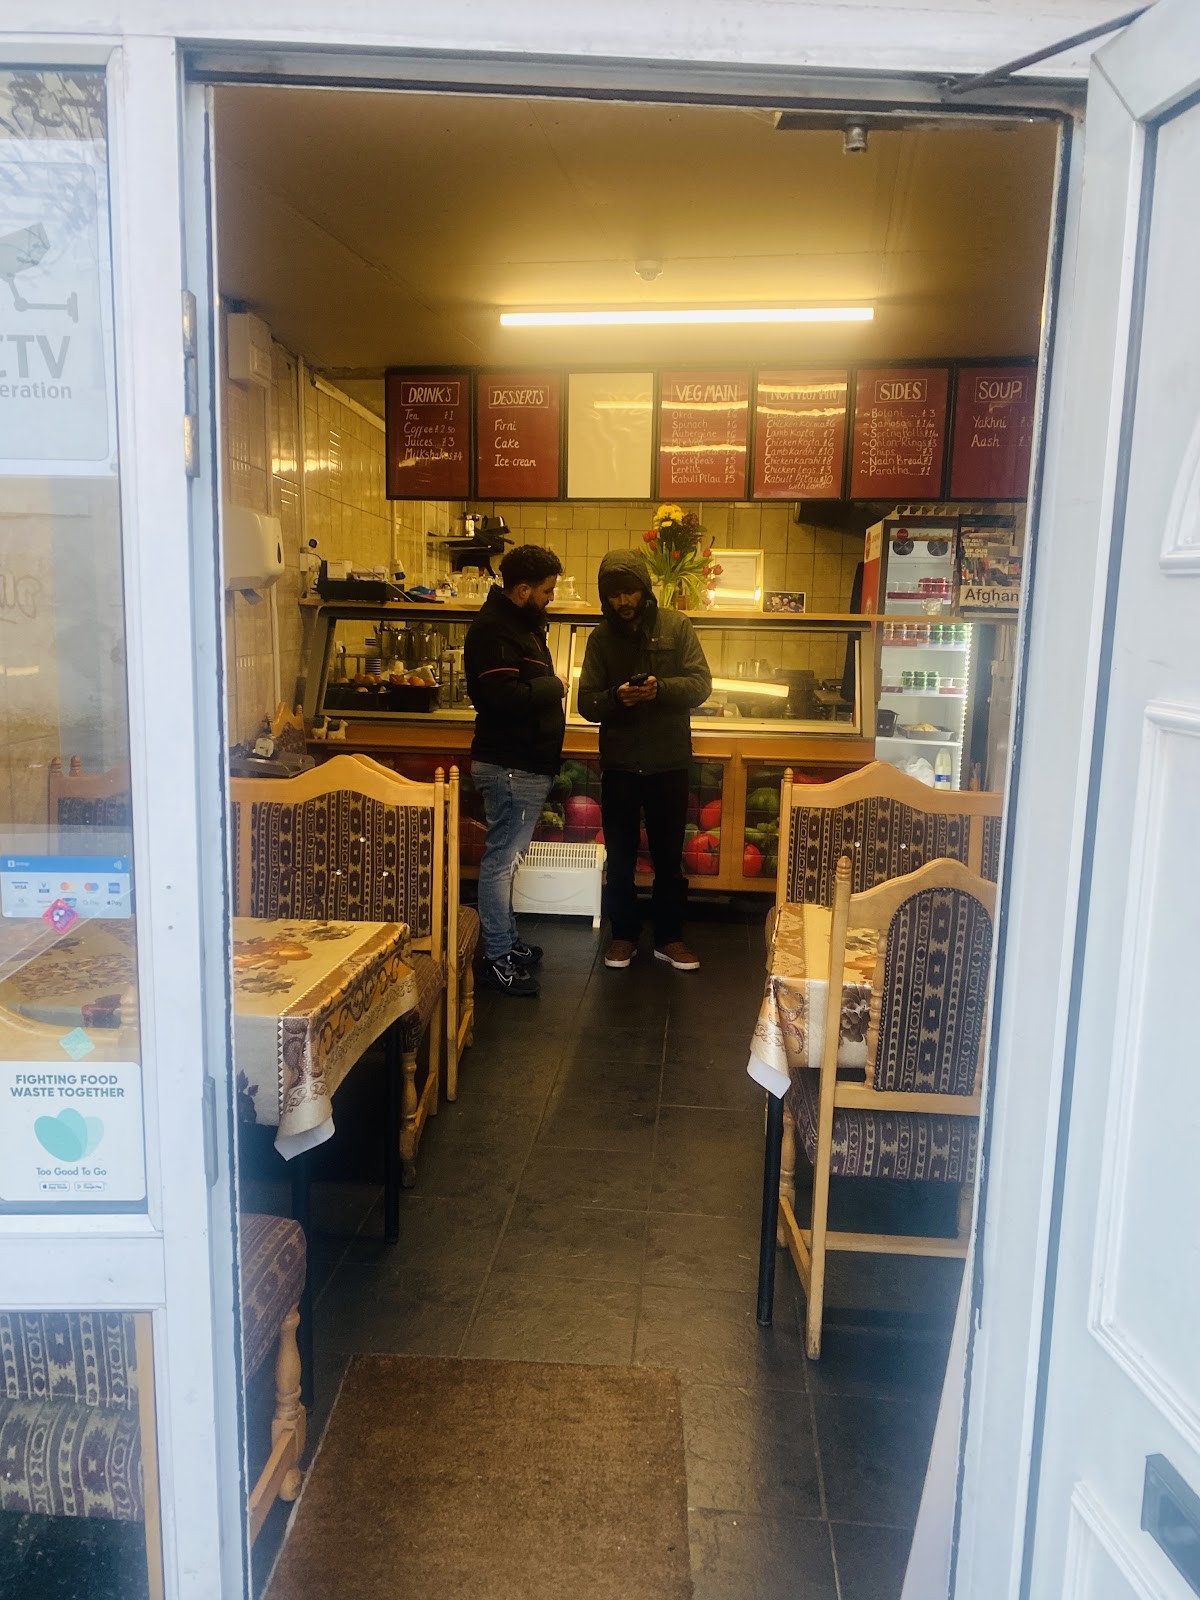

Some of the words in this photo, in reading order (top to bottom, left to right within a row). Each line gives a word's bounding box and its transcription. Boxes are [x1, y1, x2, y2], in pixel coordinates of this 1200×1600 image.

[0, 334, 71, 379] TV
[675, 384, 702, 401] VEG
[704, 384, 738, 402] MAIN
[880, 382, 922, 400] SIDES
[979, 381, 1022, 400] SOUP
[490, 389, 544, 405] DESSERTS
[404, 408, 420, 420] Tea
[672, 410, 693, 420] Okra
[871, 407, 904, 418] Bolani
[494, 418, 517, 431] Firni
[672, 419, 708, 431] Spinach
[767, 419, 798, 428] Chicken
[799, 419, 825, 428] Korma
[973, 415, 1007, 428] Yakhni
[403, 421, 433, 438] Coffee
[672, 429, 717, 440] Aubergine
[766, 428, 788, 438] Lamb
[870, 428, 902, 440] Spring
[404, 434, 433, 447] Juices
[494, 436, 520, 449] Cake
[765, 438, 797, 447] Chicken
[869, 438, 898, 448] Onion
[901, 436, 927, 451] Rings
[970, 433, 1000, 448] Aash
[765, 446, 789, 456] Lamb
[869, 447, 896, 458] Chips
[671, 456, 715, 467] Chickpeas
[764, 455, 794, 465] Chicken
[869, 456, 895, 466] Naan
[896, 454, 922, 466] Bread
[764, 465, 796, 474] Chicken
[797, 465, 817, 477] Legs
[869, 465, 910, 476] Paratha
[671, 474, 698, 484] Kabuli
[699, 473, 721, 484] Pilau
[965, 588, 1019, 603] Afghan
[15, 1074, 77, 1085] FIGHTING
[80, 1075, 118, 1085] FOOD
[10, 1087, 55, 1097] WASTE
[57, 1087, 125, 1098] TOGETHER
[36, 1167, 52, 1176] Too
[54, 1166, 79, 1176] Good
[81, 1167, 91, 1176] To
[93, 1167, 107, 1176] Go
